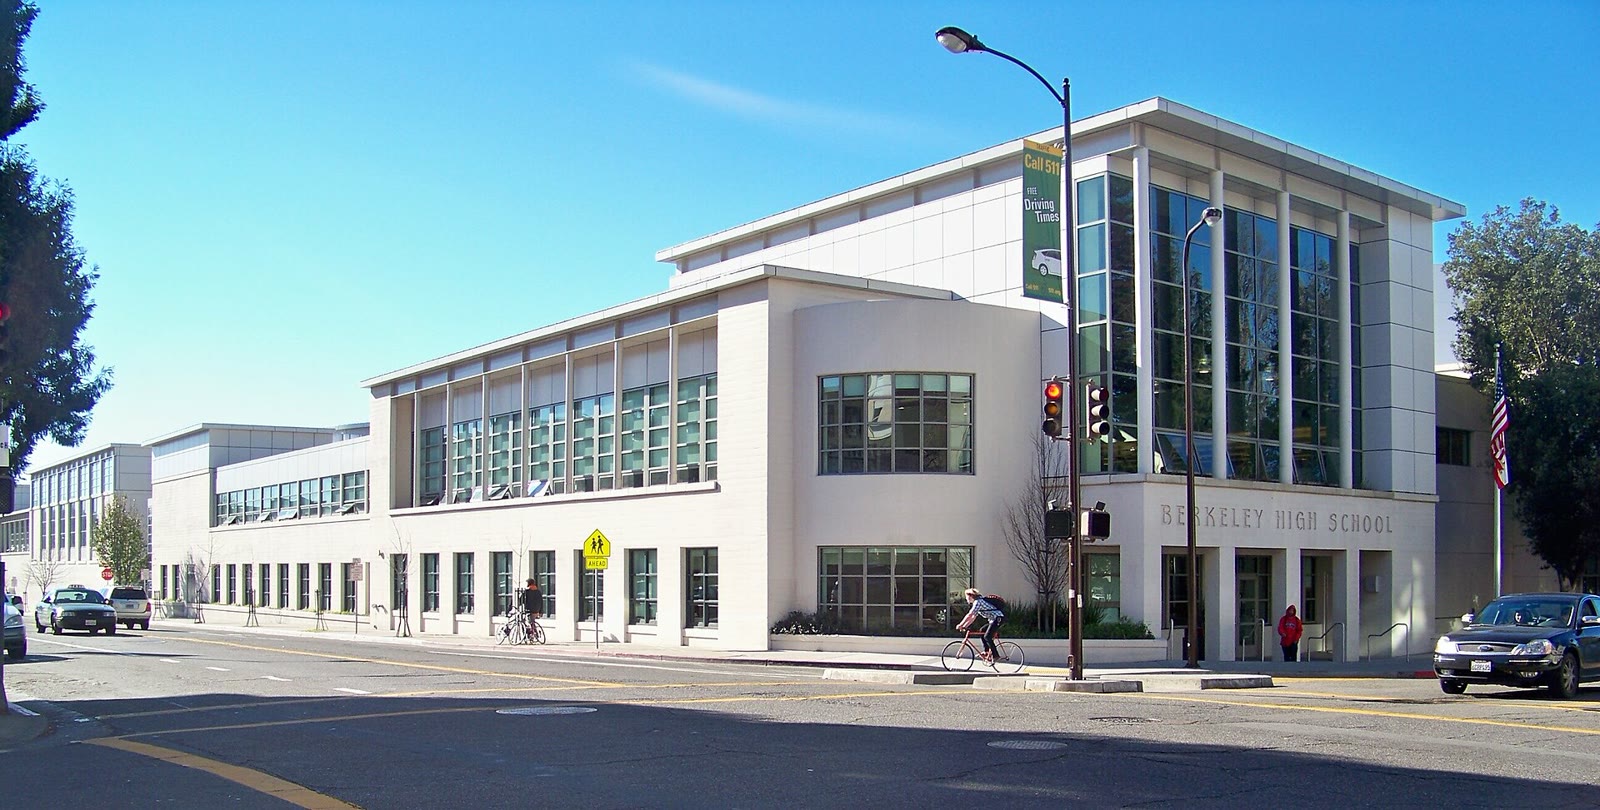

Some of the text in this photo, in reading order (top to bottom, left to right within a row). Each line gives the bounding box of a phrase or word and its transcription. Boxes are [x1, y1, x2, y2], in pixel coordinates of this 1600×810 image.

[1024, 153, 1060, 176] Call 511
[1026, 187, 1038, 195] FREE
[1024, 197, 1055, 212] Driving
[1034, 211, 1060, 223] Times
[1161, 504, 1394, 534] BERKELEY HIGH SCHOOL
